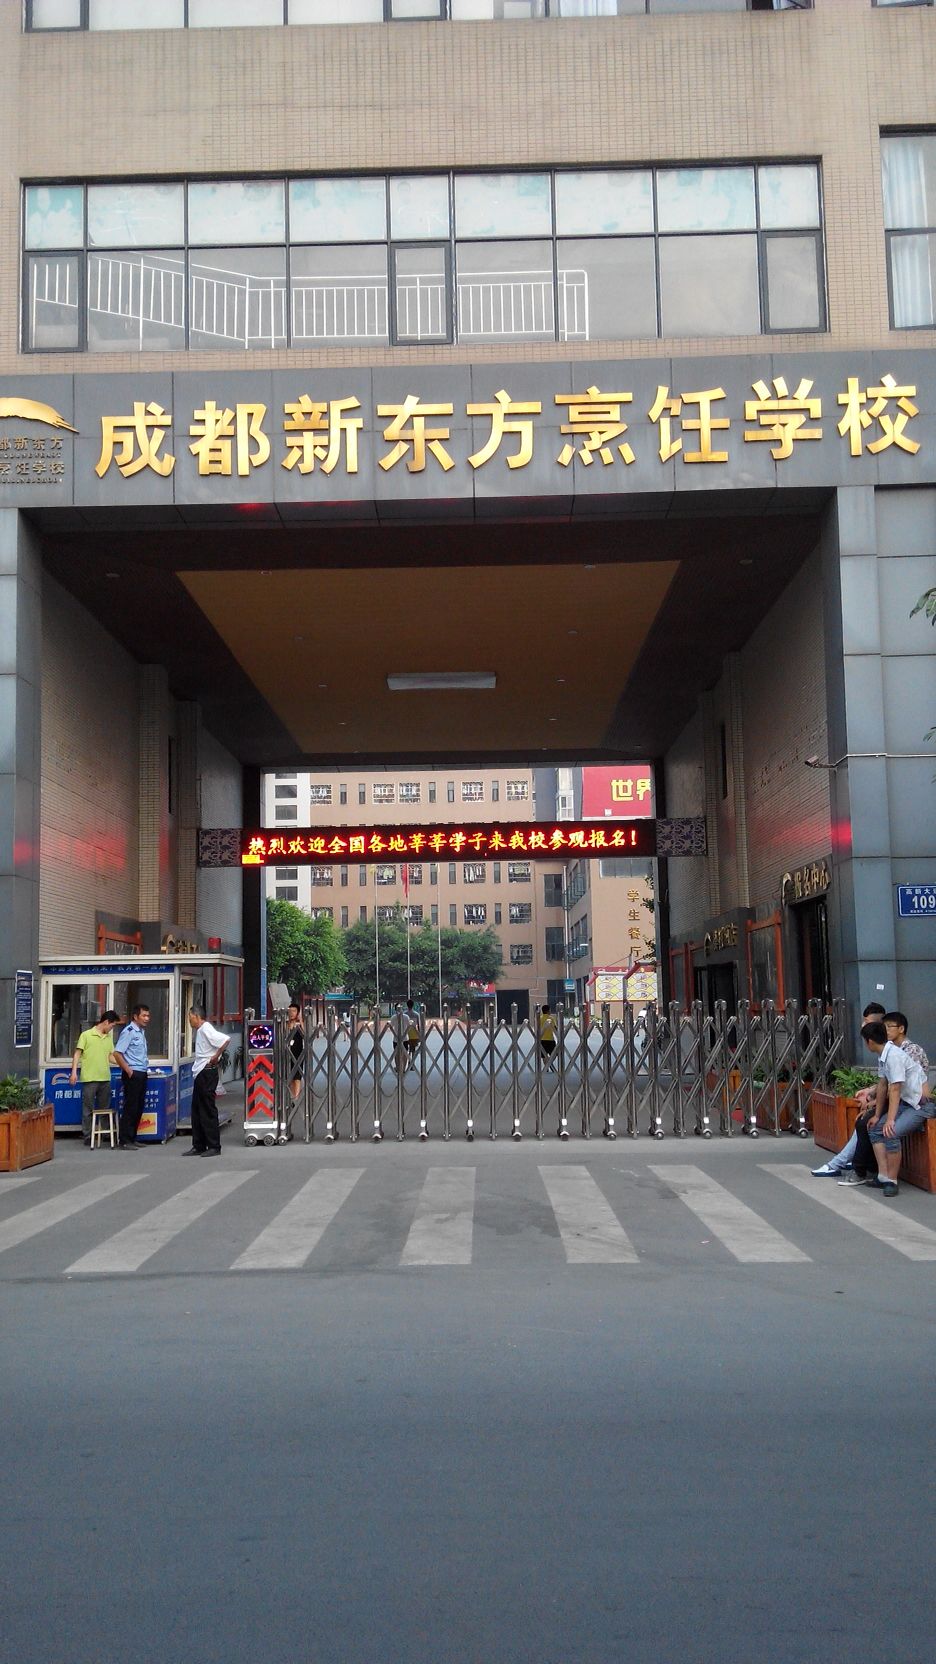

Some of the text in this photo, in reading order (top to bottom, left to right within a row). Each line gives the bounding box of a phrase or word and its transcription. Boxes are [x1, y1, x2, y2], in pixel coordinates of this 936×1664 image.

[95, 373, 922, 479] 成都新东方烹饪学校
[627, 889, 642, 958] 学生餐厅
[912, 895, 936, 909] 109
